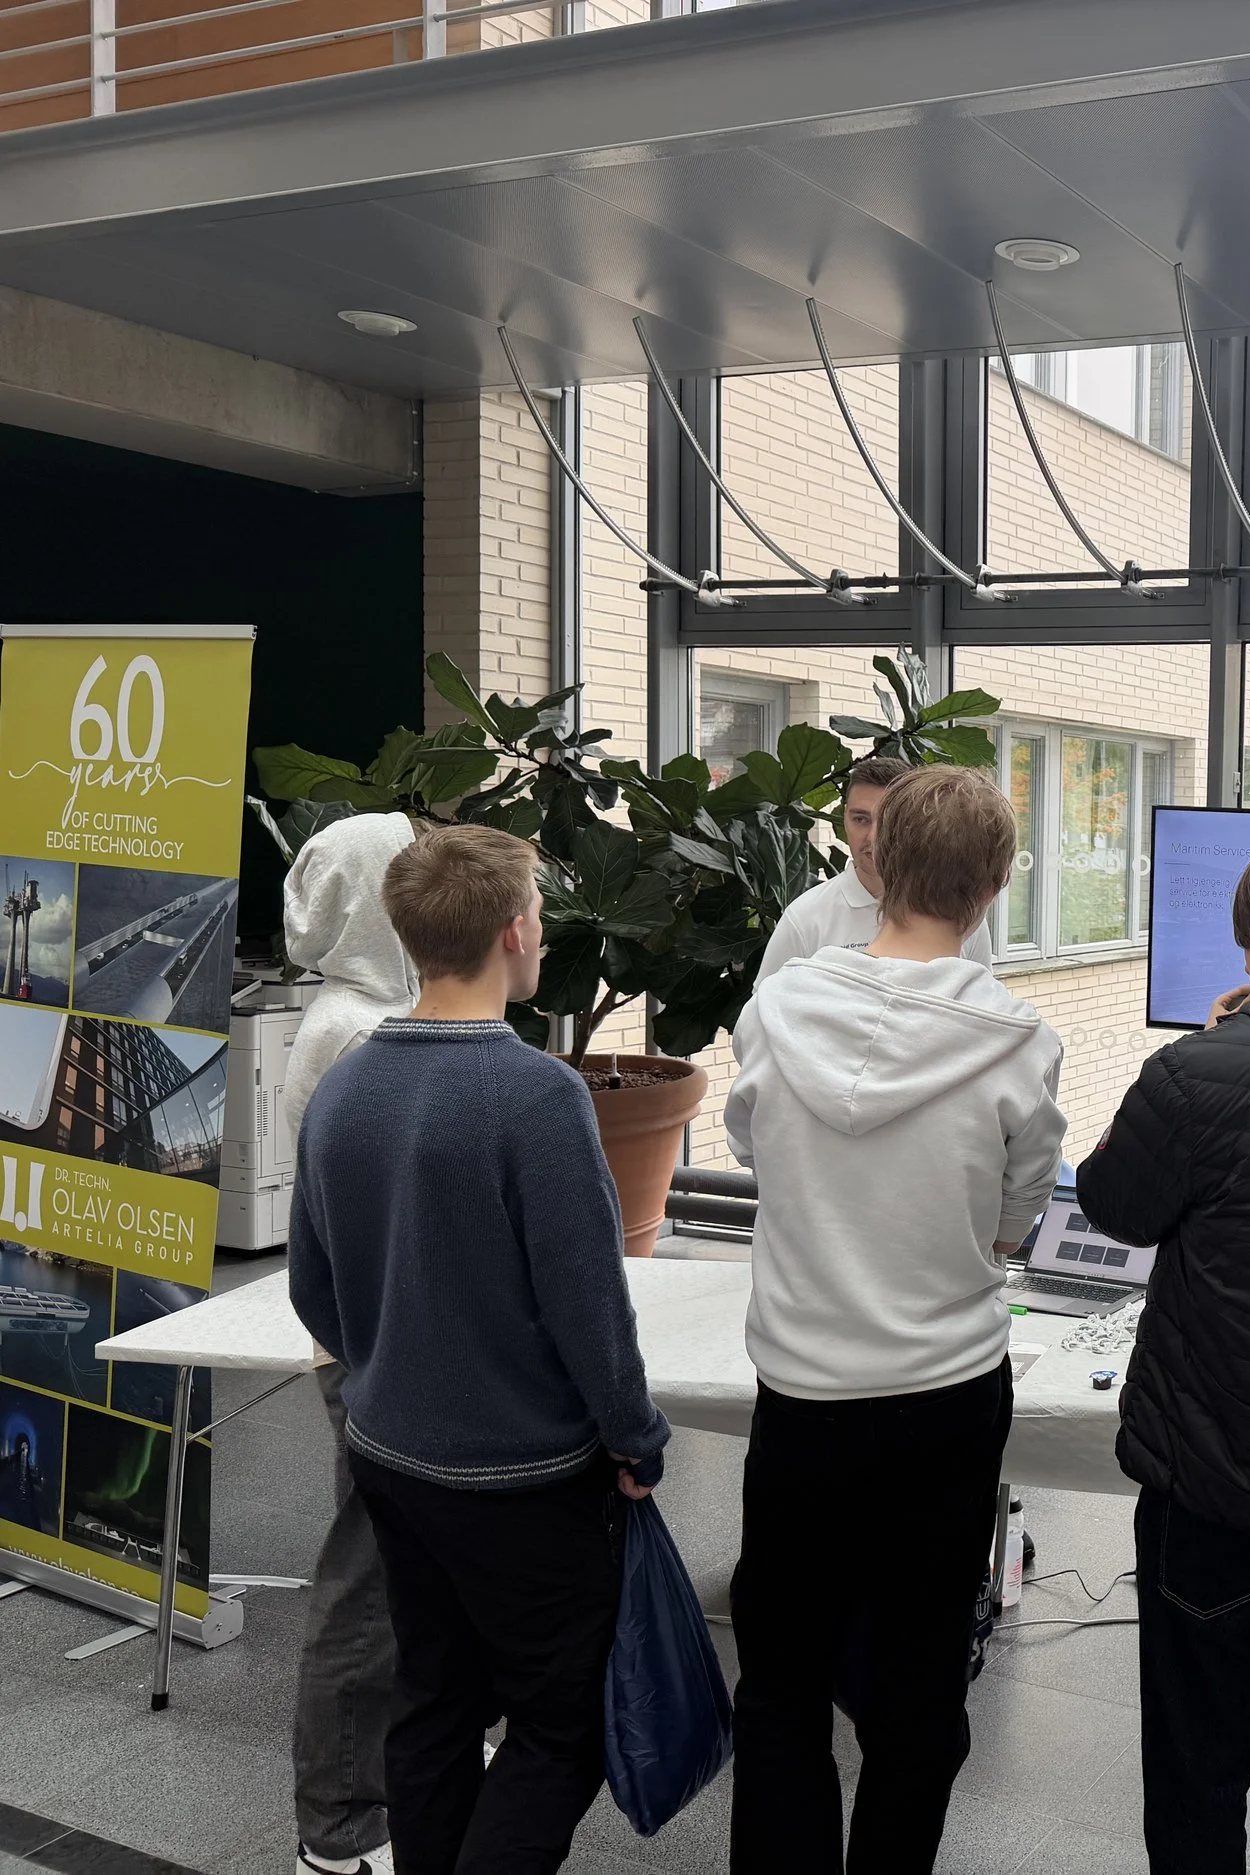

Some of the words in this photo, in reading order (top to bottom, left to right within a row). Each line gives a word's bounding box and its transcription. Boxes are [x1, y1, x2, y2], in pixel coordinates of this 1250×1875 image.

[70, 654, 165, 763] 60
[71, 811, 89, 829] OF
[93, 813, 158, 835] CUTTING
[46, 831, 80, 851] EDGE
[84, 834, 184, 860] TECHNOLOGY
[55, 1167, 71, 1184] DR.
[73, 1172, 112, 1192] TECHN.
[52, 1188, 112, 1225] OLAV
[117, 1202, 195, 1245] OLSEN
[52, 1222, 123, 1250] ARTELIA
[135, 1240, 194, 1265] GROUP
